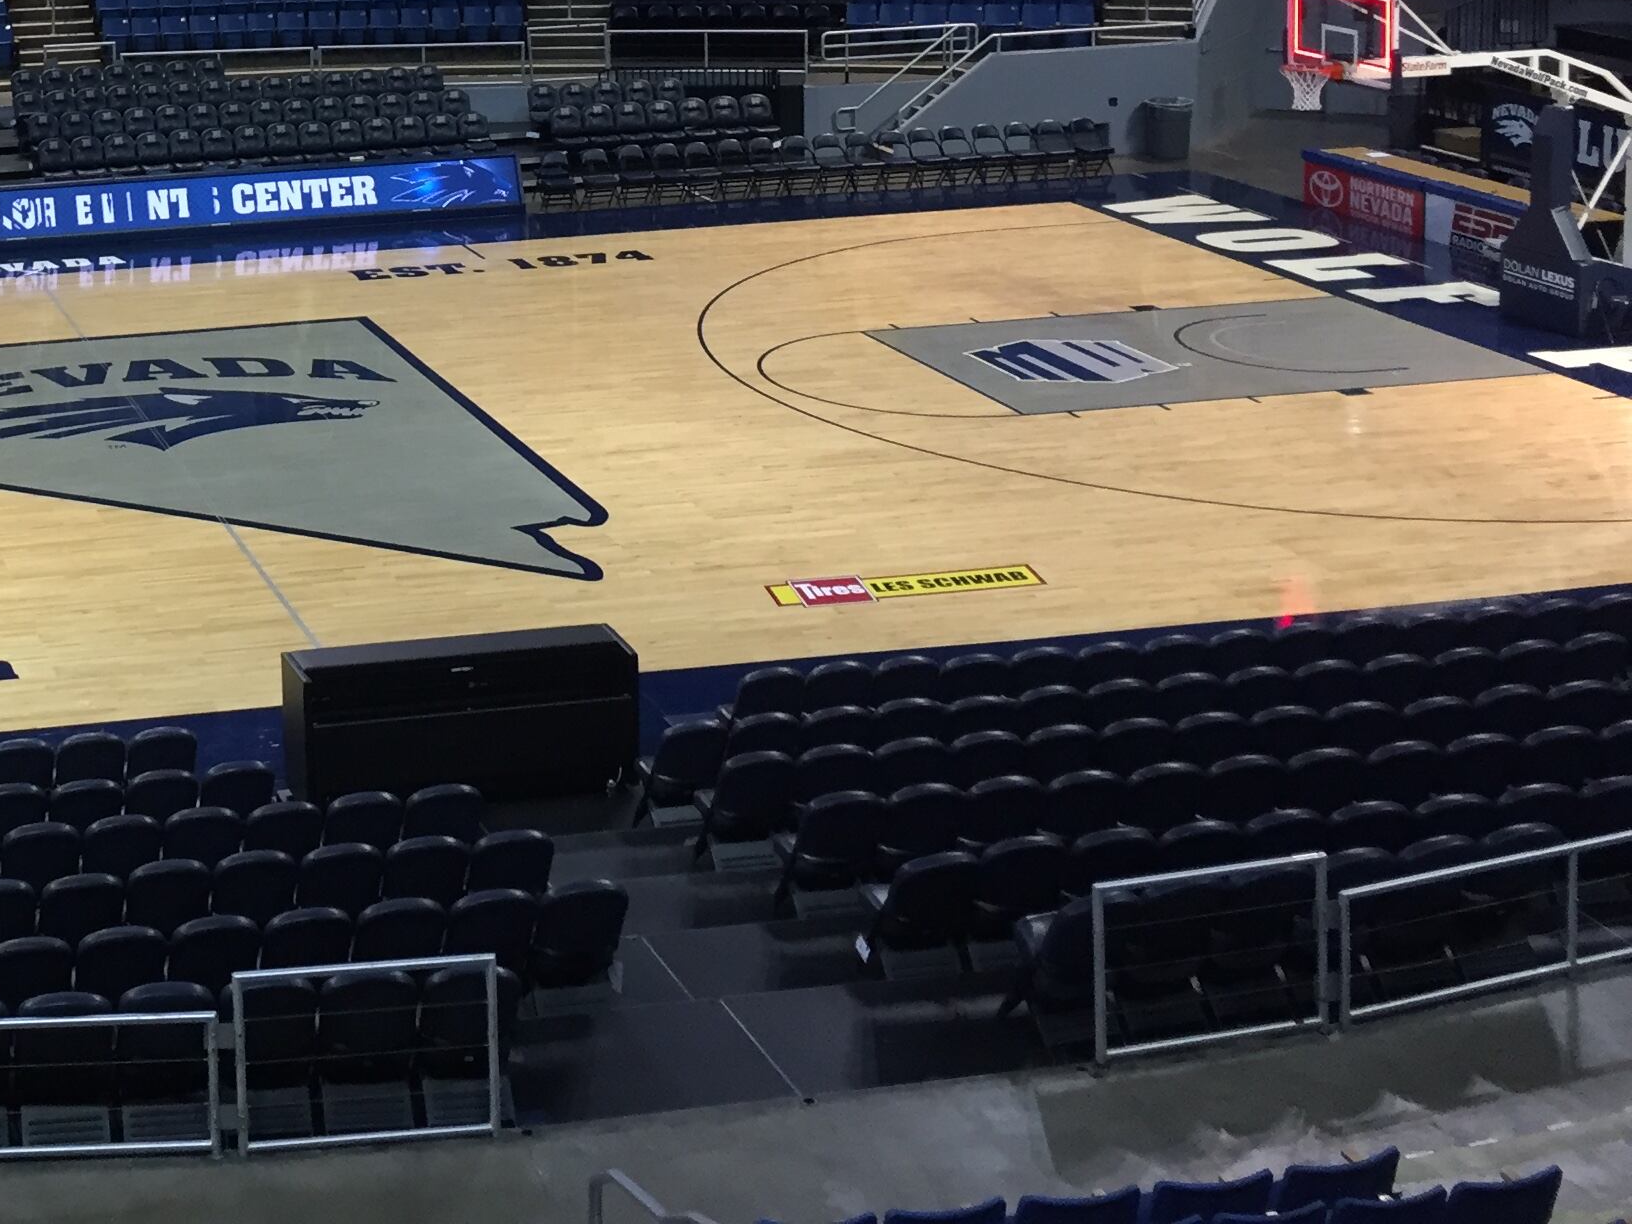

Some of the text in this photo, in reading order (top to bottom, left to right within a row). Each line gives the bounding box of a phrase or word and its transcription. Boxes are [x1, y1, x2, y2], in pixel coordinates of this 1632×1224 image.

[1490, 55, 1588, 98] NevadaWolfPack.com
[232, 175, 378, 215] CENTER
[1350, 176, 1415, 207] NORTHERN
[1350, 191, 1414, 226] NEVADA
[1452, 203, 1517, 239] ESP
[1452, 235, 1485, 253] RADIO
[348, 249, 655, 282] EST. 1874
[1504, 257, 1575, 289] DOLAN LEXUS
[794, 569, 1030, 602] Tires LES SCHWAB
